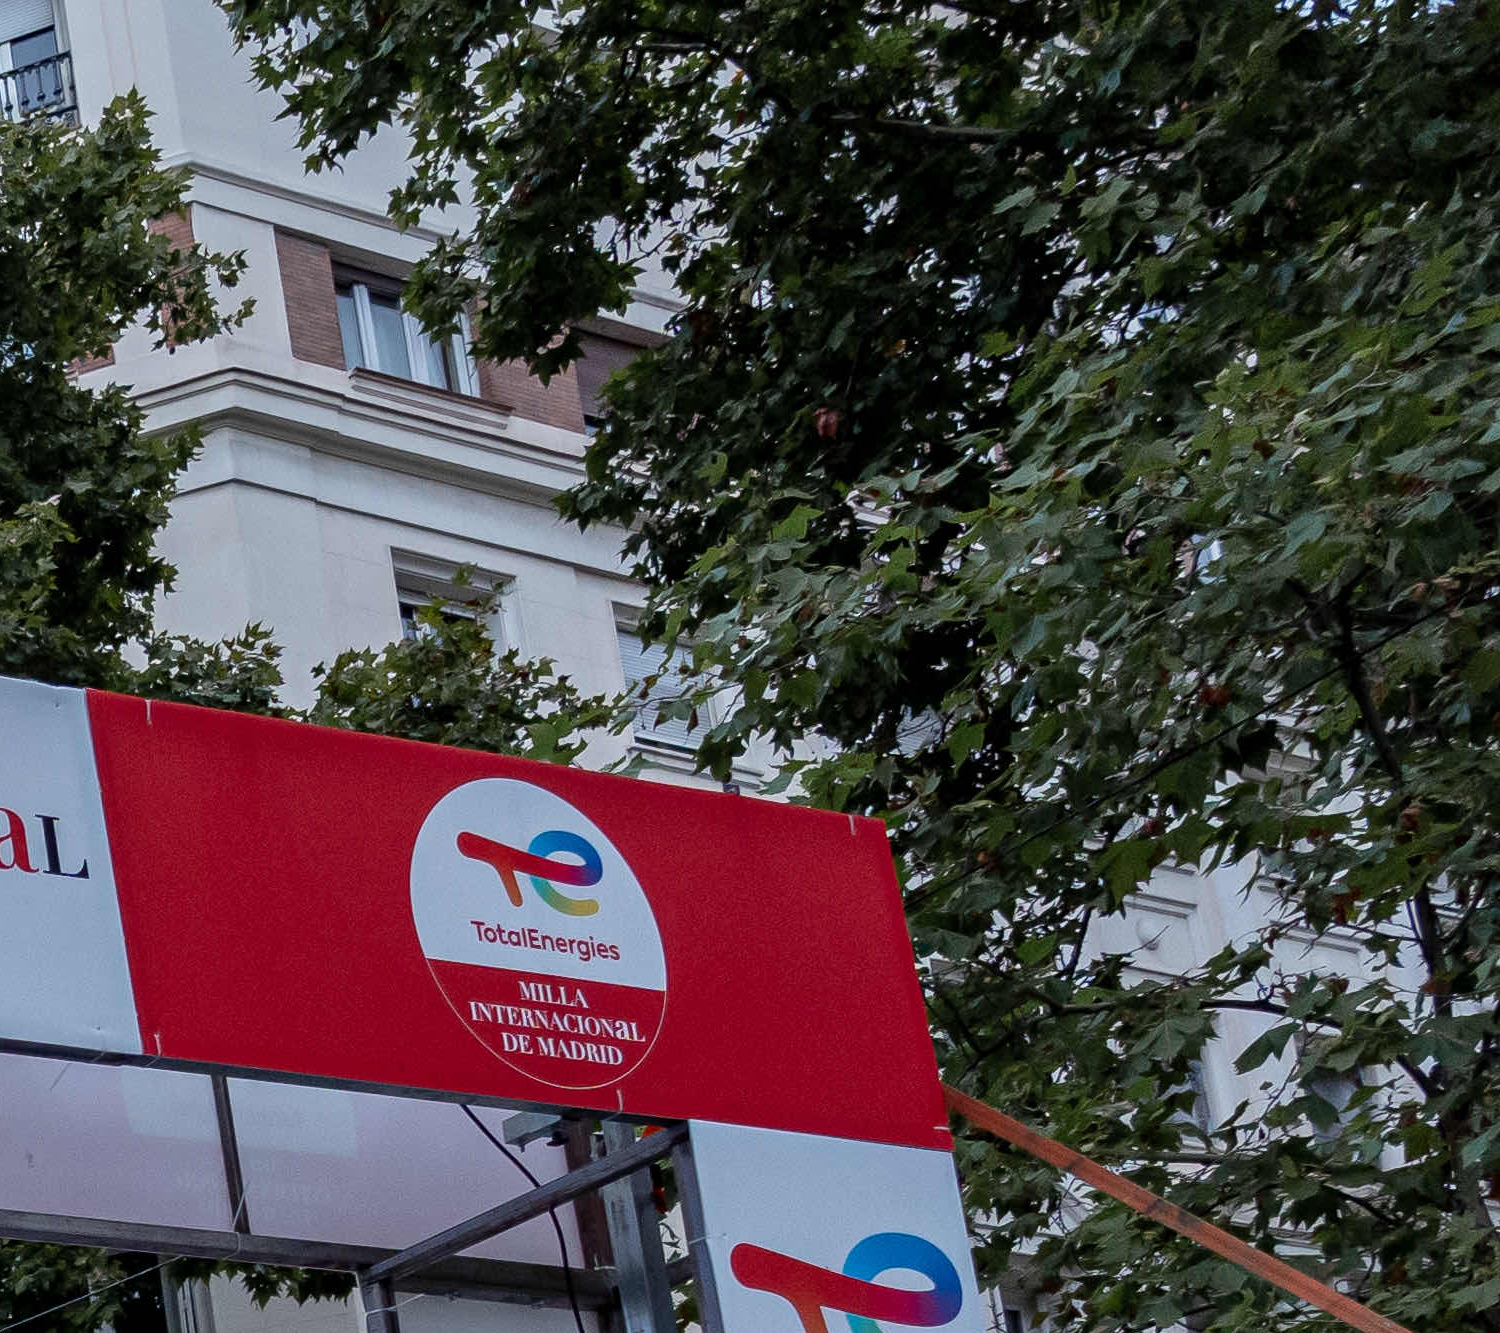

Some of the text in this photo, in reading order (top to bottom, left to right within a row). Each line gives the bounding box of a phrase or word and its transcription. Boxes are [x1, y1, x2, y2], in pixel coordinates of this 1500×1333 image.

[471, 920, 620, 962] TotalEnergies
[518, 980, 589, 1009] MILLA
[501, 1032, 623, 1066] DE MADRID
